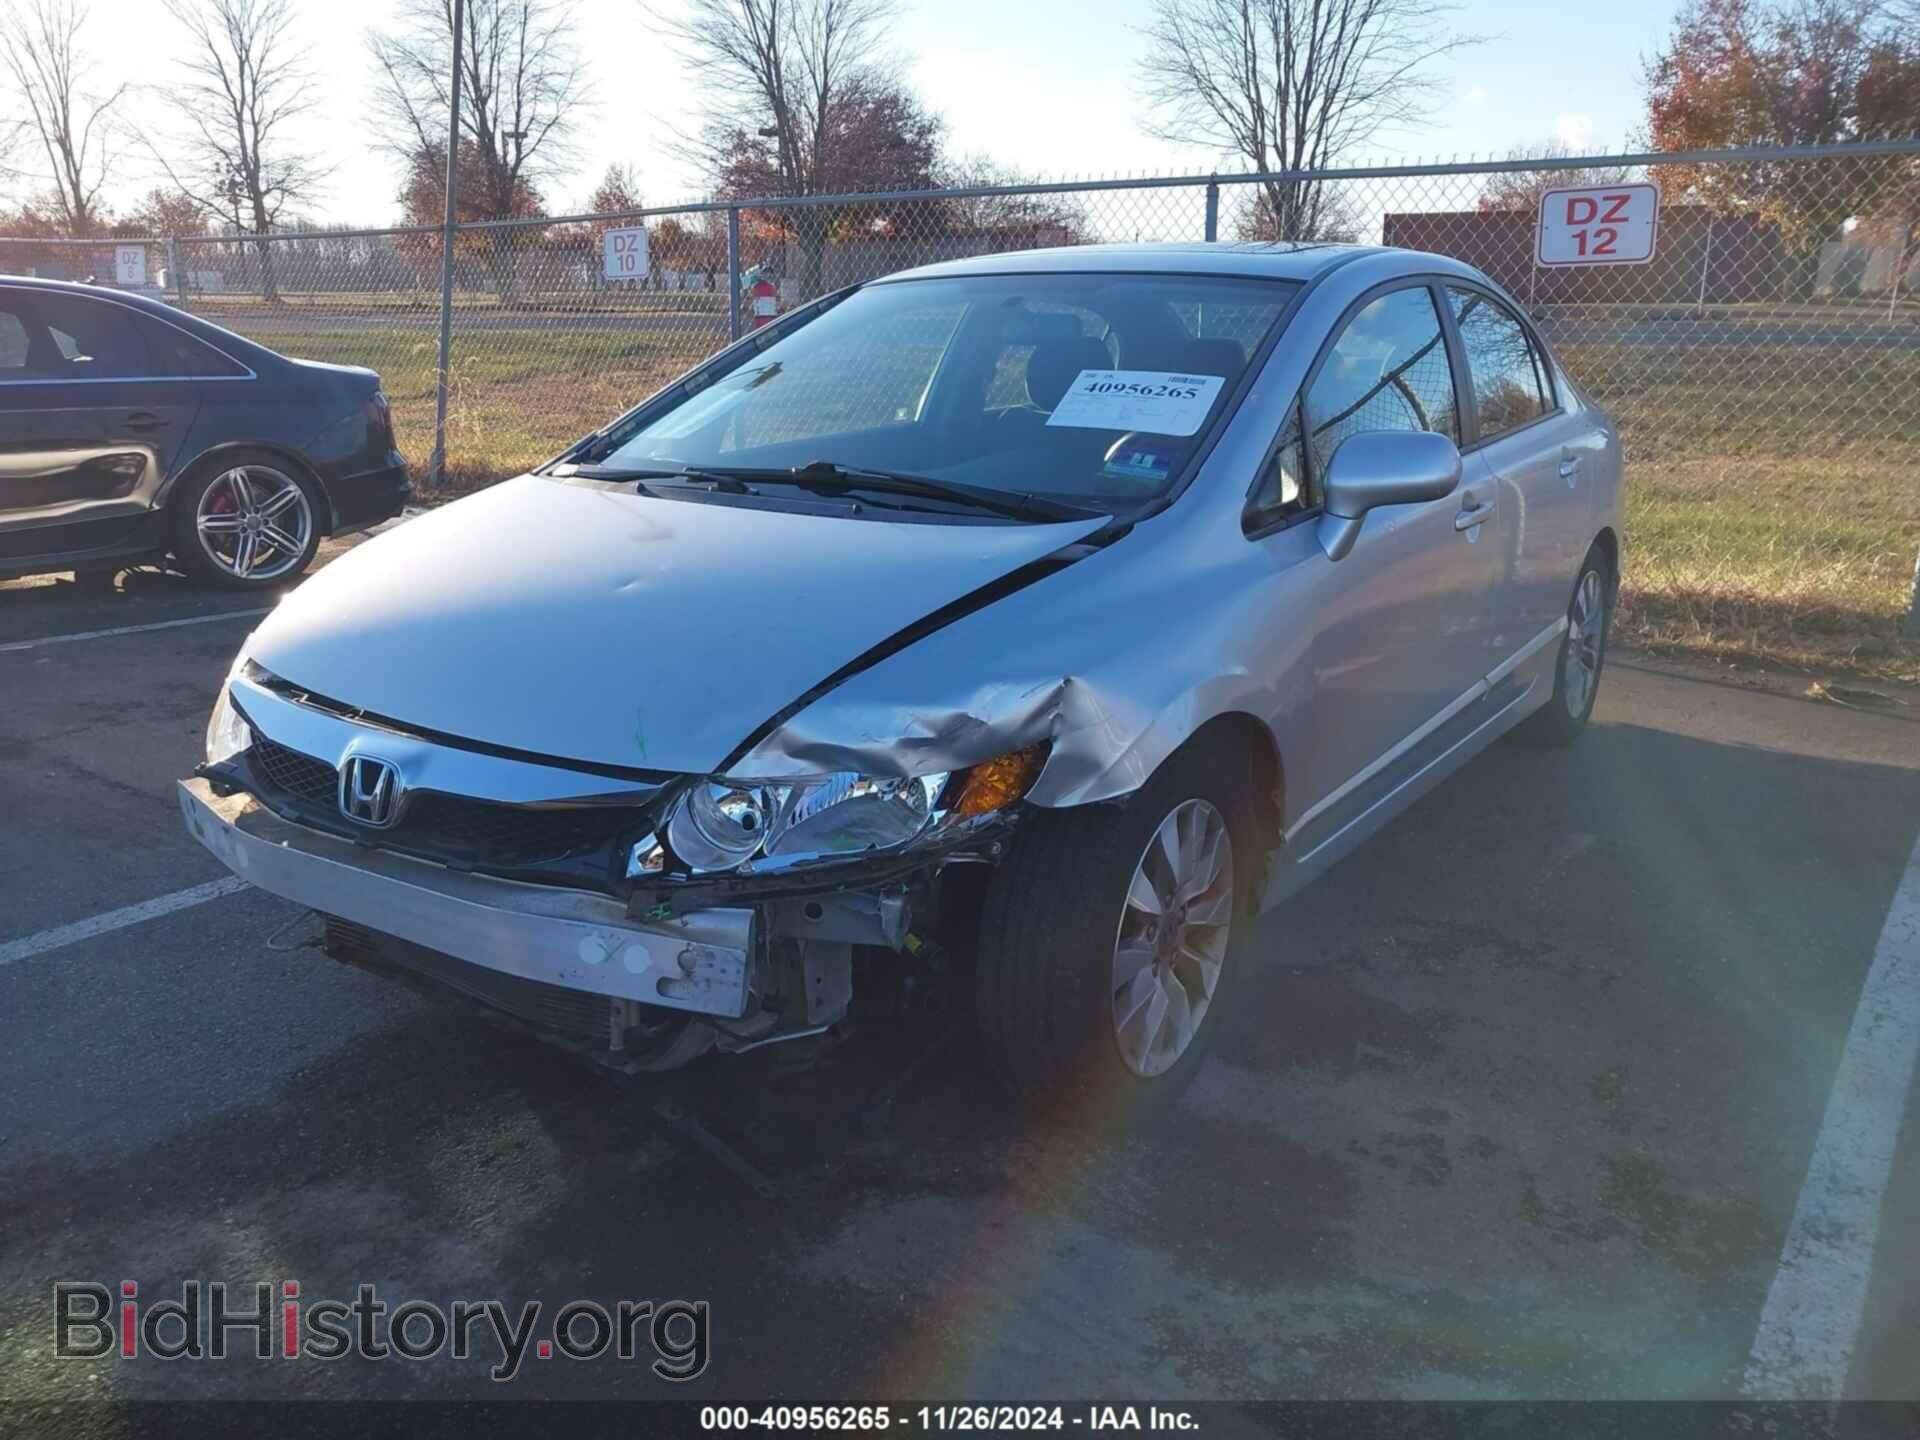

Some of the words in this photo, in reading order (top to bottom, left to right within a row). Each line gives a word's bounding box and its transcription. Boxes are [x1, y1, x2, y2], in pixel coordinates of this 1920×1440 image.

[1565, 194, 1632, 226] DZ
[613, 234, 639, 252] DZ
[1571, 227, 1618, 256] 12
[122, 250, 139, 265] DZ
[617, 254, 636, 272] 10
[1084, 381, 1199, 400] 40956265
